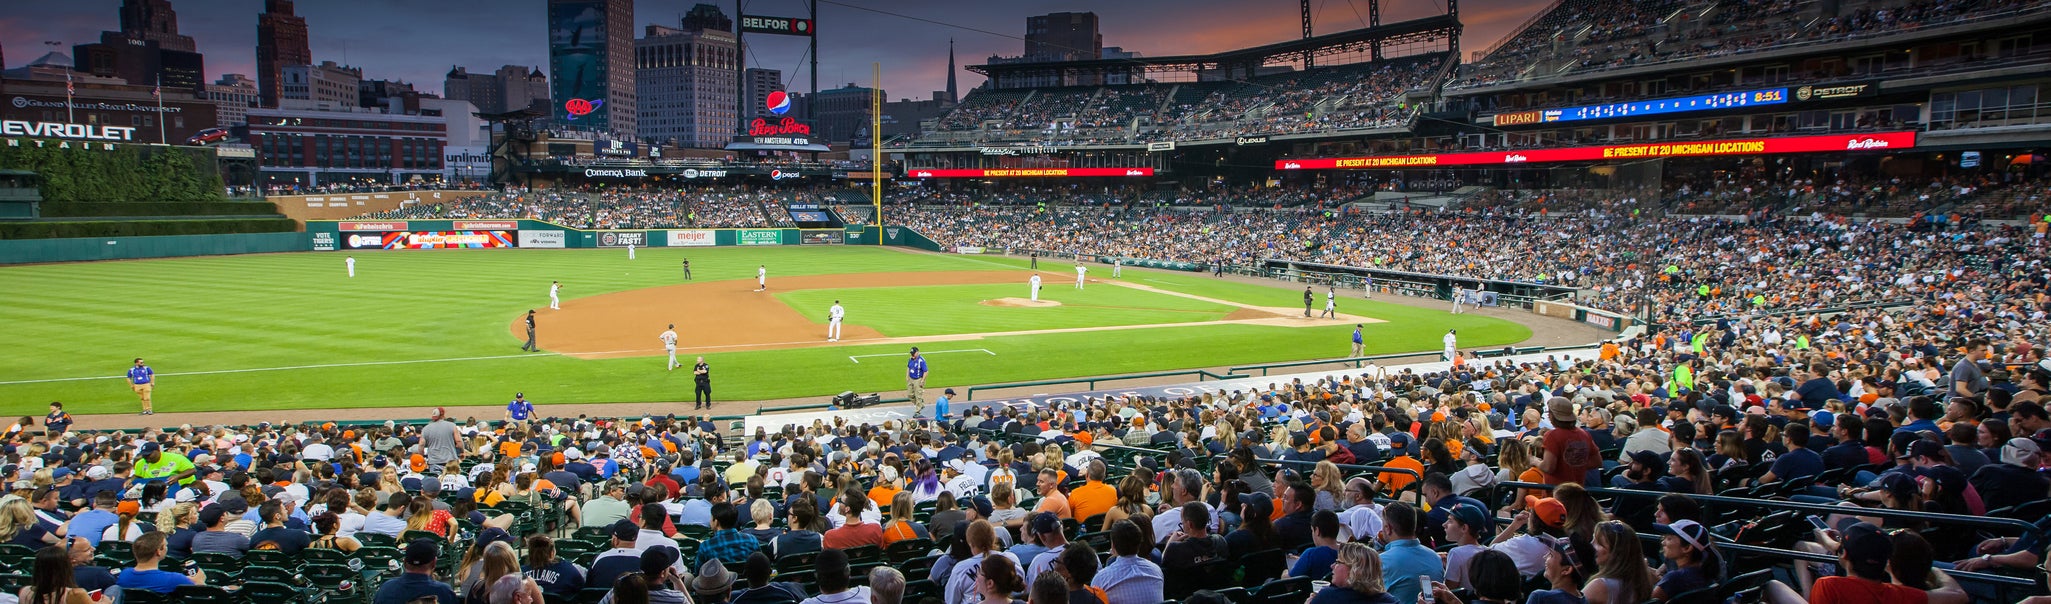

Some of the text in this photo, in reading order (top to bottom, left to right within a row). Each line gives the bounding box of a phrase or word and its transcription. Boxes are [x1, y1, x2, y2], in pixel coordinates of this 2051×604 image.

[742, 17, 789, 30] BELFOR
[1813, 84, 1868, 95] DETROIT
[1754, 90, 1782, 103] 8:51
[27, 99, 182, 113] GRAND VALLEY STATE UNIVERSITY
[566, 100, 592, 114] AAA
[1500, 112, 1535, 125] LIPARI
[0, 119, 136, 140] EVROLET
[749, 116, 811, 136] PEPSI PORCH
[764, 137, 792, 145] AMSTERDAM
[1847, 138, 1888, 149] Red Robin
[1603, 141, 1765, 157] BE PRESENT AT 20 MICHIGAN LOCATIONS
[1336, 156, 1437, 167] BE PRESENT AT 20 MICHIGAN LOCATIONS
[625, 168, 647, 177] Bank
[677, 232, 706, 241] meijer
[742, 230, 777, 238] EASTERN
[618, 237, 642, 245] FAST!
